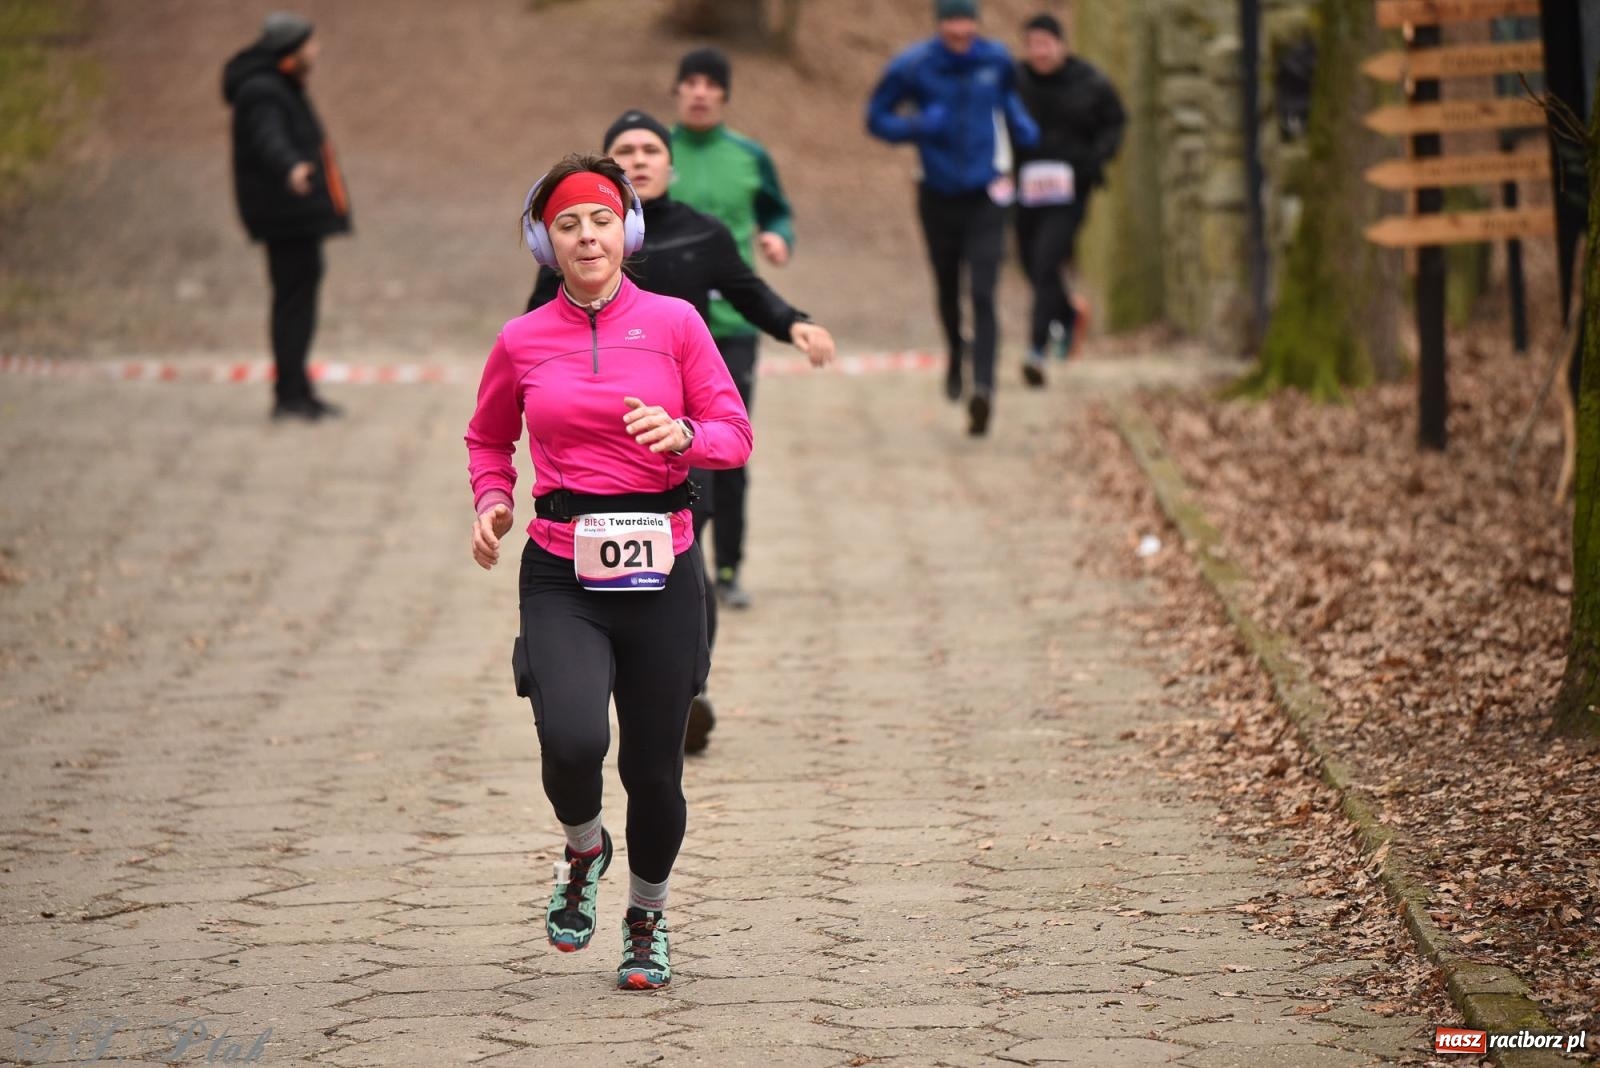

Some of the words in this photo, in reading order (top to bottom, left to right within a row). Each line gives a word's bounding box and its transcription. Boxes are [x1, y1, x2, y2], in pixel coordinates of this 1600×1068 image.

[584, 518, 606, 526] BIEG
[609, 517, 664, 526] Twardziela
[600, 540, 653, 568] 021
